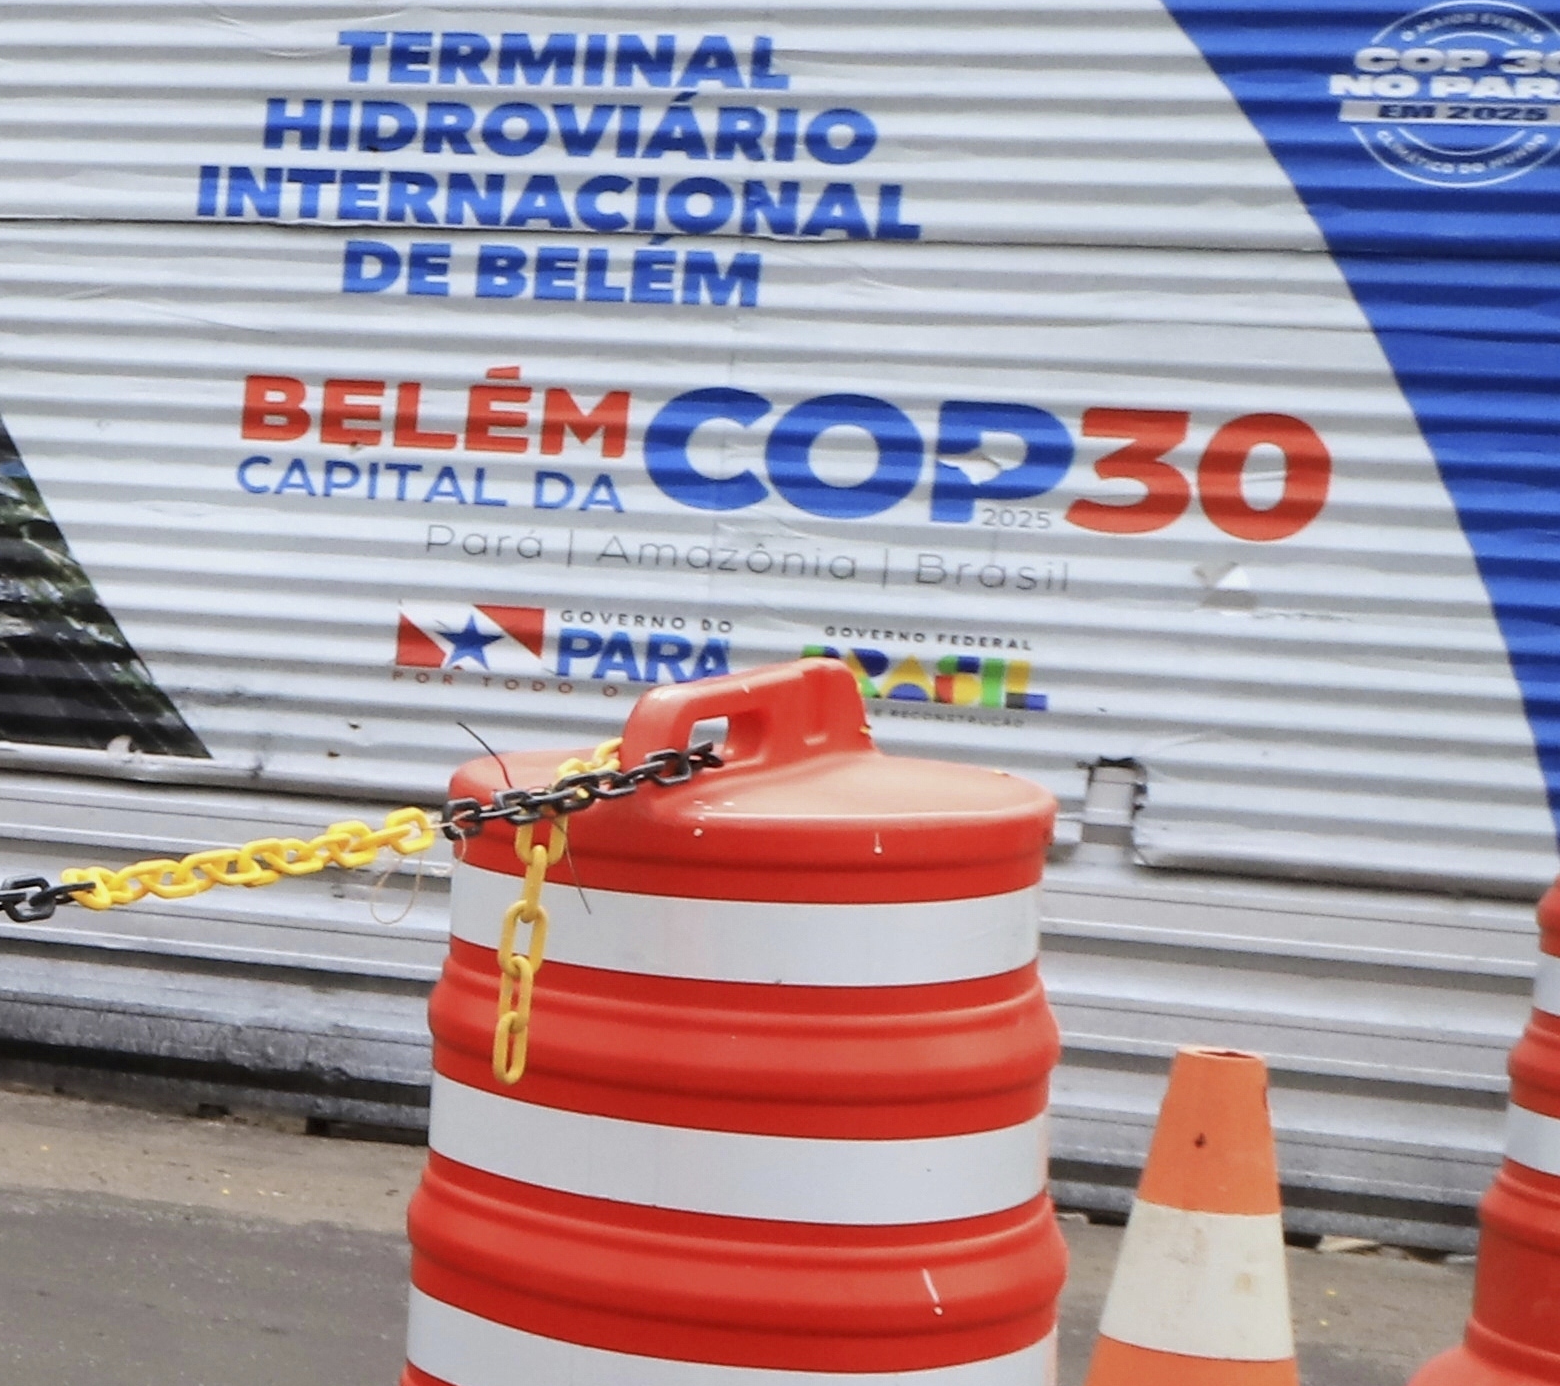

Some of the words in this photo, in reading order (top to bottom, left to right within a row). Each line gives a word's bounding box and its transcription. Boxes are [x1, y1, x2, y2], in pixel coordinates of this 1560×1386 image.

[338, 30, 789, 90] TERMINAL
[1354, 47, 1489, 72] COP
[1329, 74, 1420, 98] NO
[262, 92, 877, 165] HIDROVIÁRIO
[1378, 104, 1437, 118] EM
[1446, 106, 1549, 121] 2025
[196, 165, 921, 240] INTERNACIONAL
[342, 240, 452, 296] DE
[475, 236, 761, 307] BELÉM
[241, 365, 632, 458] BELÉM
[237, 456, 507, 507] CAPITAL
[534, 470, 624, 513] DA
[982, 507, 1052, 529] 2025
[426, 524, 542, 559] Pará
[596, 533, 857, 580] Amazônia
[915, 552, 1071, 592] Brasil
[561, 609, 685, 630] GOVERNO
[701, 618, 733, 634] DO
[824, 625, 927, 644] GOVERNO
[937, 633, 1033, 652] FEDERAL
[392, 669, 454, 686] POR
[483, 675, 574, 694] TODO
[602, 684, 619, 698] O
